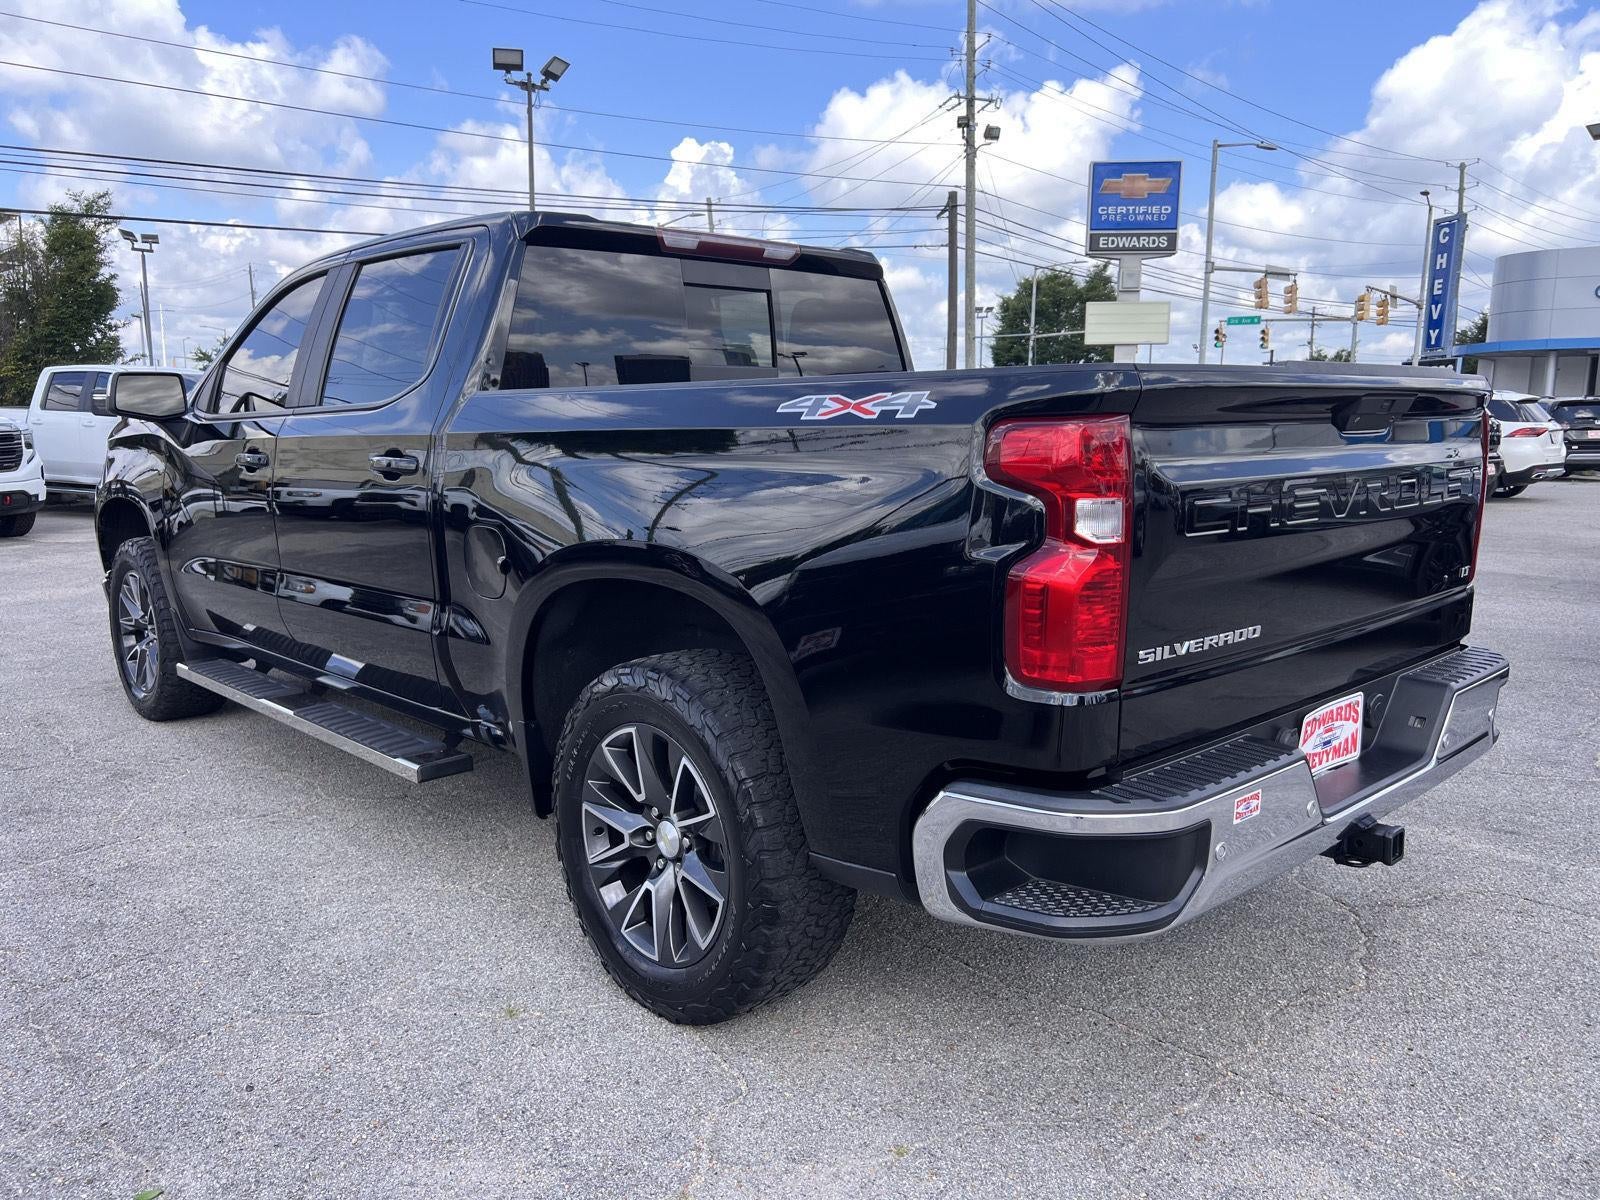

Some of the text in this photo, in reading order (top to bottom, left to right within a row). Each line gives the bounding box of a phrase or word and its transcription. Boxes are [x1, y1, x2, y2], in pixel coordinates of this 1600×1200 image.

[1098, 205, 1172, 214] CERTIFIED
[1099, 236, 1168, 248] EDWARDS
[1429, 227, 1450, 345] CHEVY
[1184, 465, 1481, 537] CHEVROLET
[1137, 625, 1262, 665] SILVERADO
[1302, 700, 1360, 747] EDWARDS
[1236, 792, 1260, 809] EDWARDS
